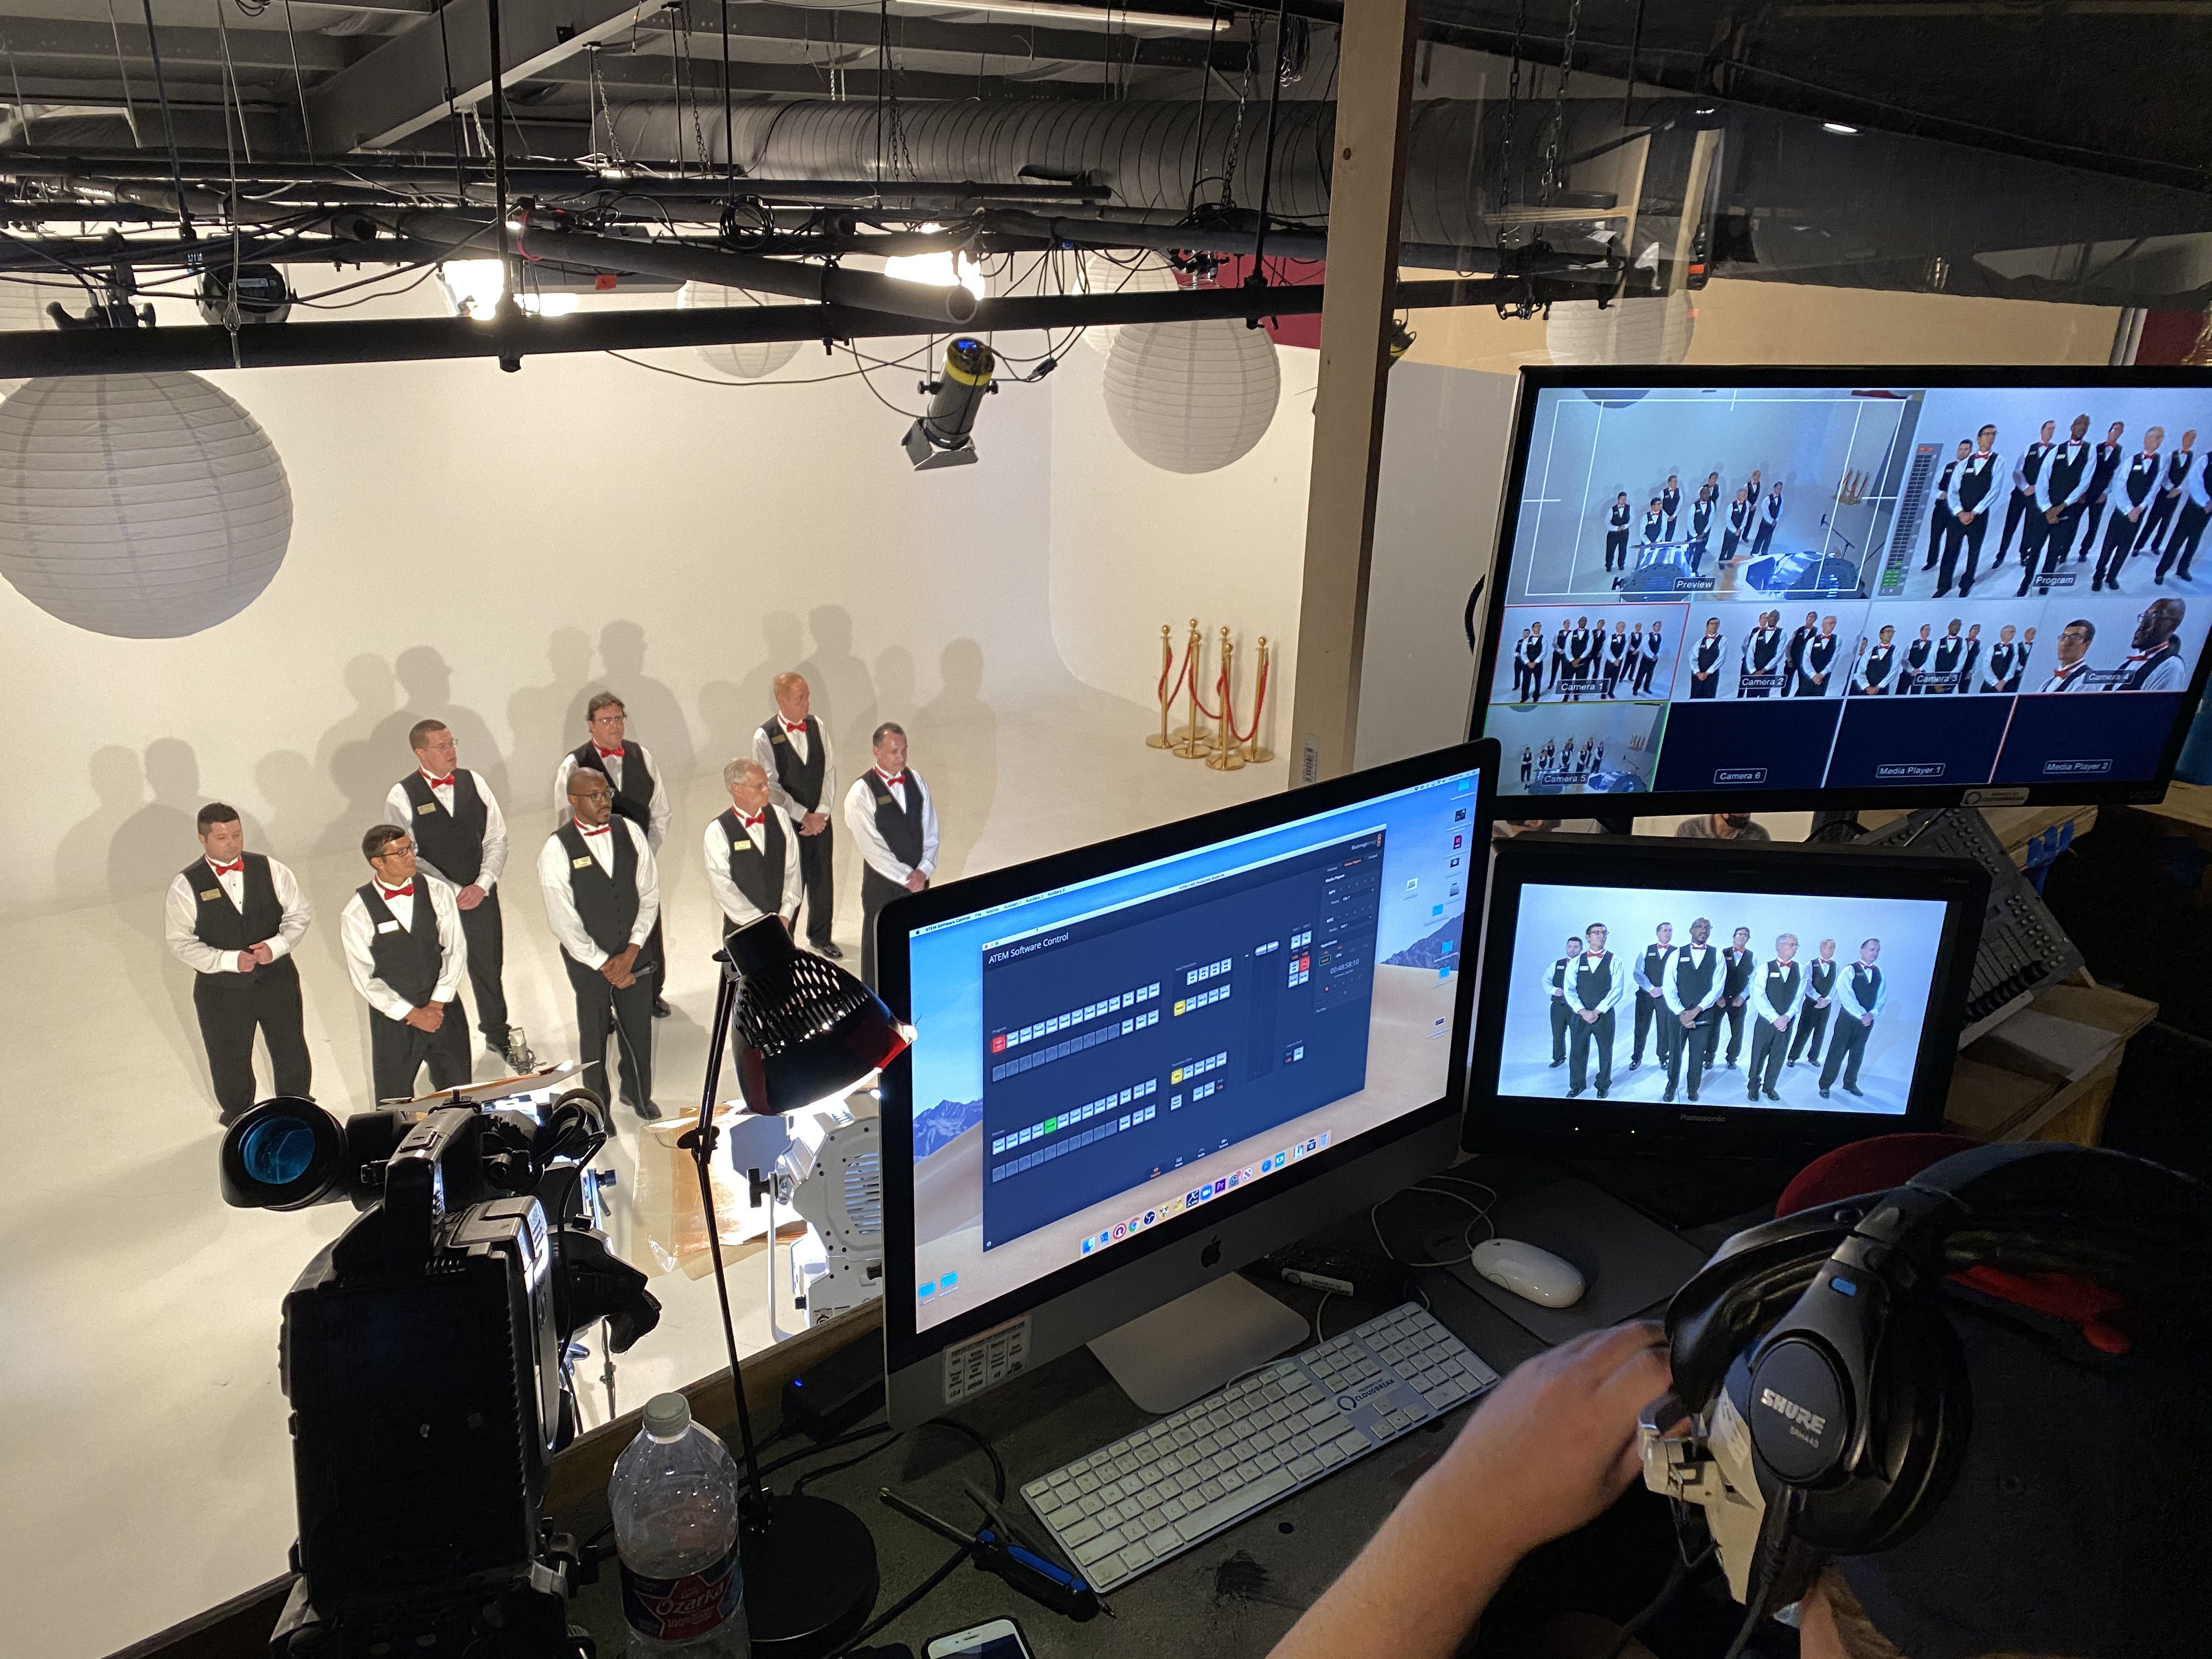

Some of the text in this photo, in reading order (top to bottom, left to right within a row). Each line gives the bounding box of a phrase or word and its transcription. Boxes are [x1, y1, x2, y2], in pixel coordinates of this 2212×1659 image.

[1676, 580, 1712, 588] Preview
[2036, 575, 2073, 585] Program
[1908, 766, 1933, 775] Player
[2074, 763, 2101, 771] Player
[988, 932, 1069, 964] ATEM Software Control
[1680, 1114, 1725, 1122] Panasonic
[1216, 1182, 1224, 1190] Pr
[1355, 1378, 1396, 1402] CLOUDBREAK
[1760, 1388, 1826, 1435] SHURE
